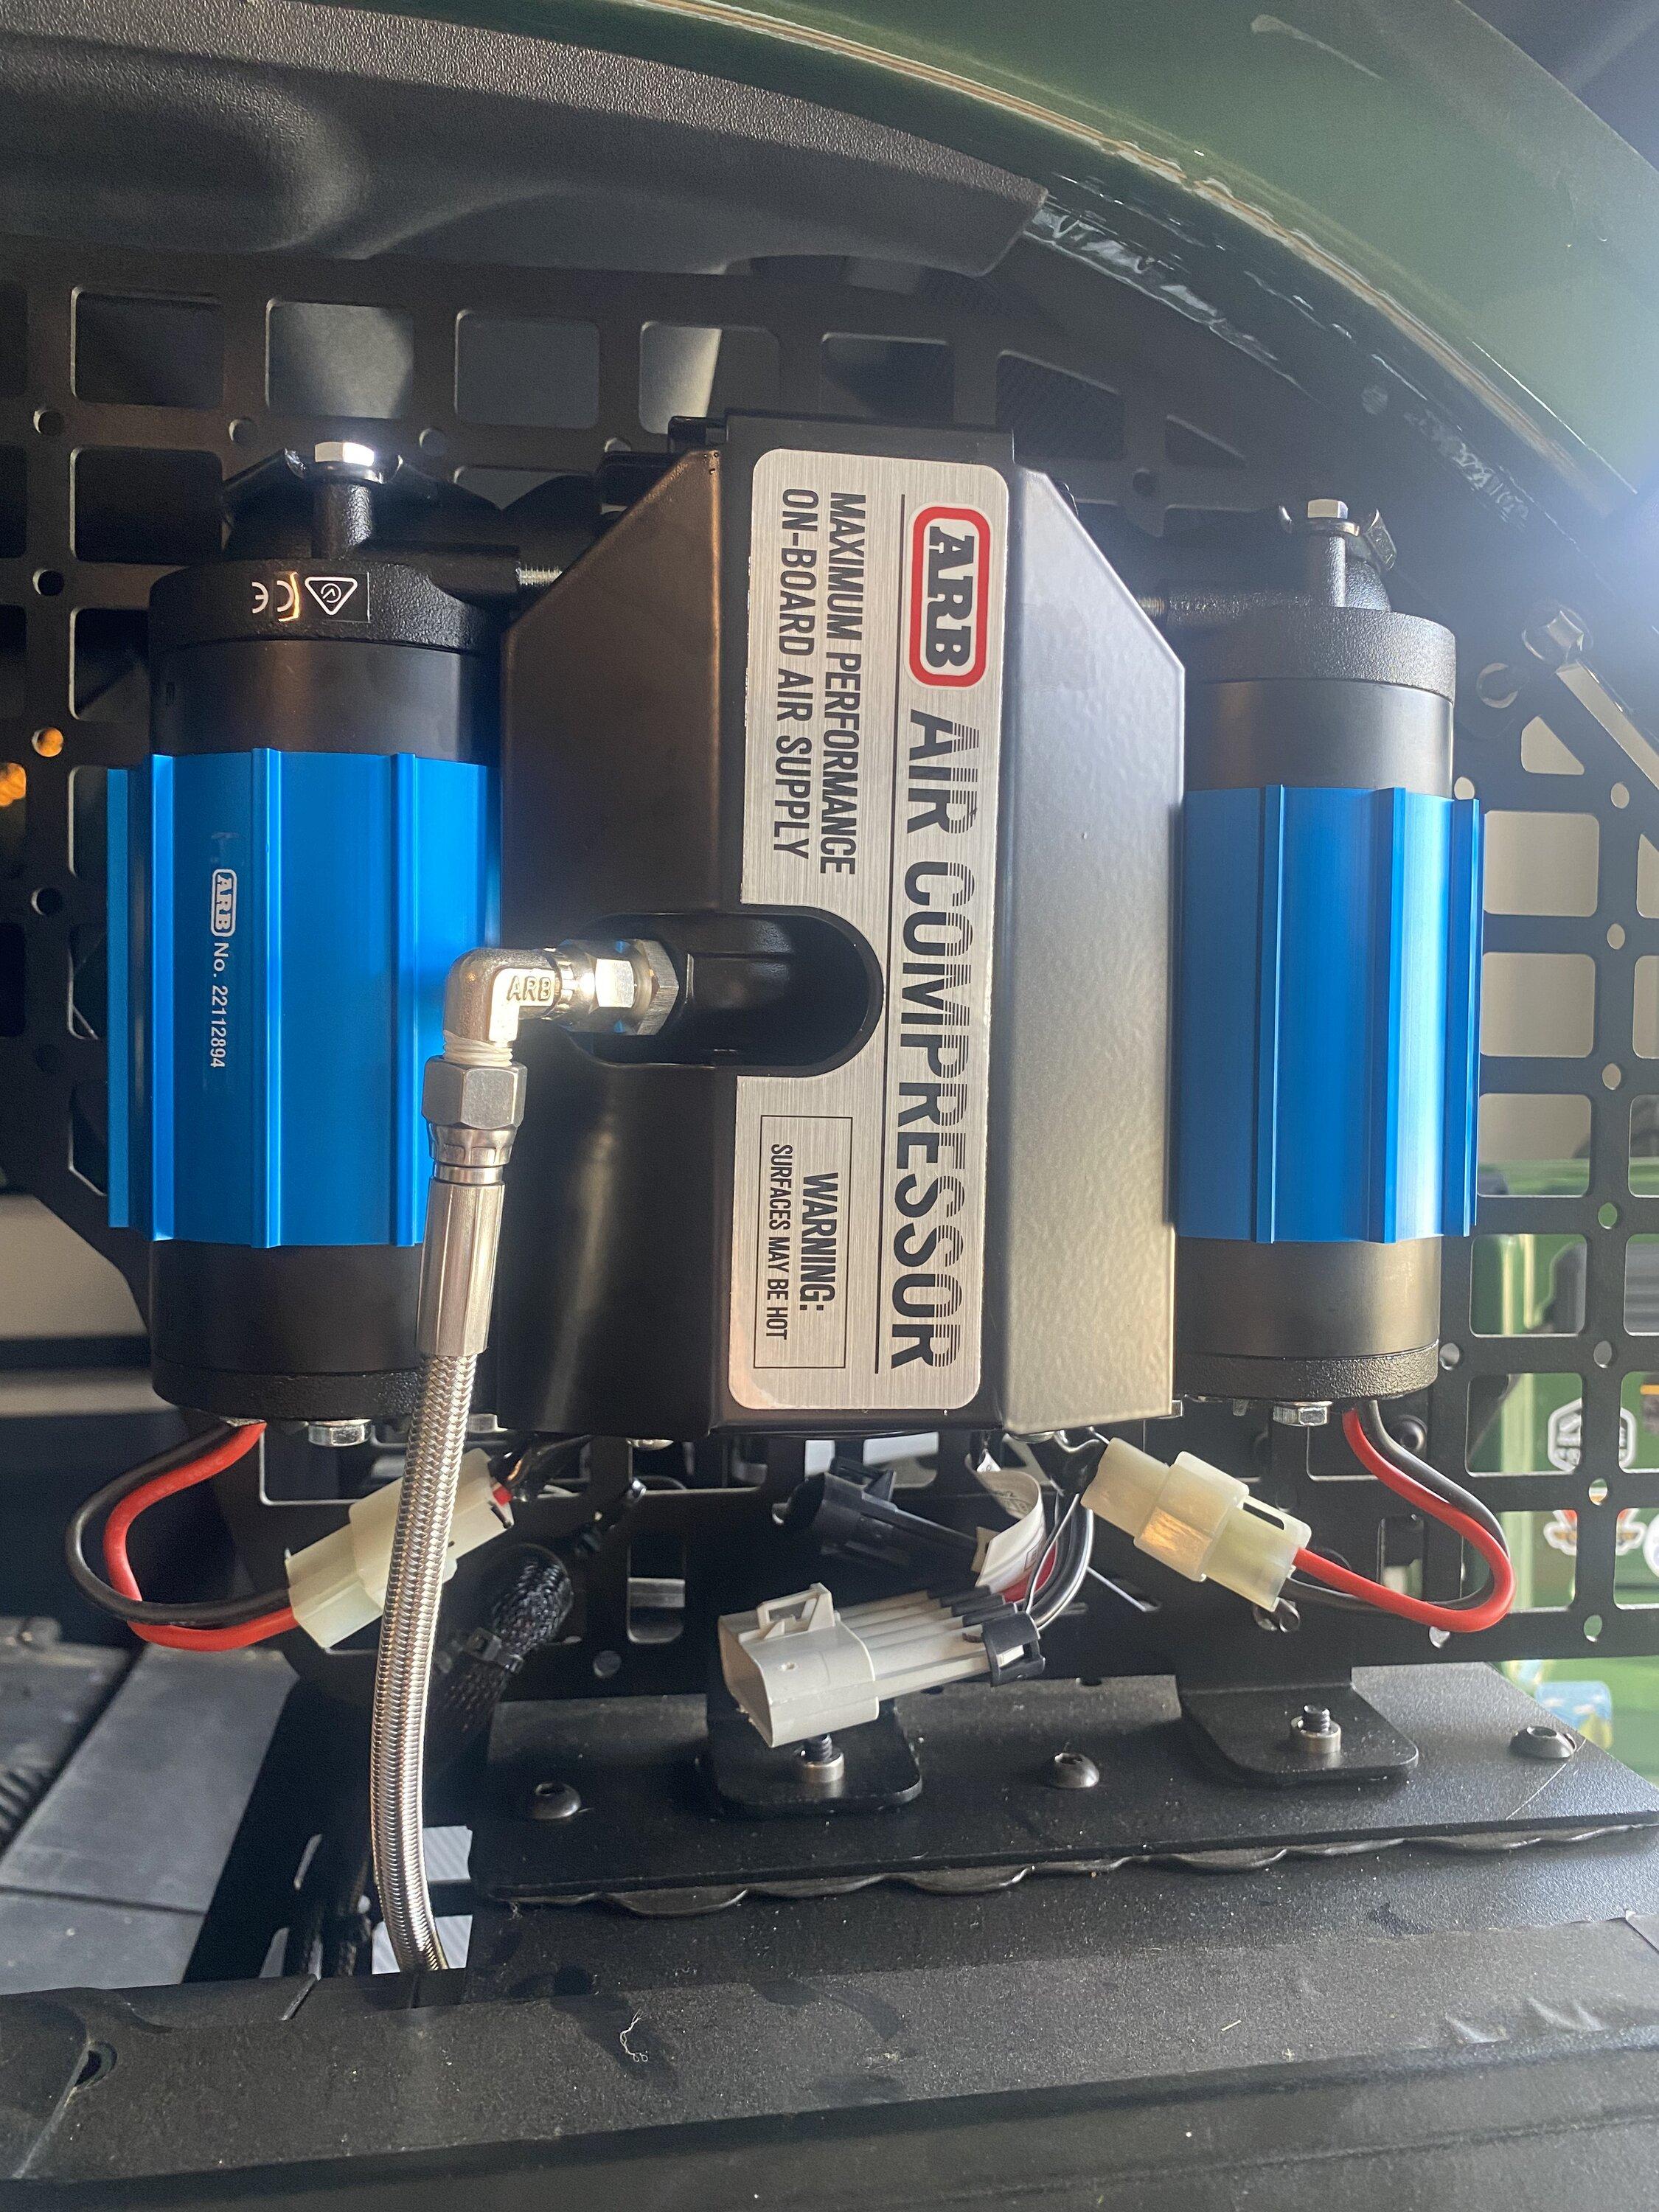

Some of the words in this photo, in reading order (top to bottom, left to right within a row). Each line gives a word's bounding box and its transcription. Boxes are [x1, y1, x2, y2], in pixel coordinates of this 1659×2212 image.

[778, 488, 819, 657] ON-BOARD
[826, 492, 866, 641] MAXIMUM
[925, 526, 975, 668] ARB
[776, 667, 813, 722] AIR
[773, 735, 812, 860] SUPPLY
[820, 651, 862, 875] PERFORMANCE
[906, 709, 979, 834] AIR
[215, 874, 233, 931] ARB
[213, 942, 229, 978] No.
[506, 975, 553, 1002] ARB
[210, 985, 229, 1068] 22112894
[890, 860, 975, 1369] COMPRESSOR
[768, 1144, 793, 1231] SURFACES
[767, 1236, 790, 1273] MAY
[799, 1172, 838, 1312] WARNING:
[765, 1307, 787, 1340] HOT
[766, 1278, 788, 1301] BE
